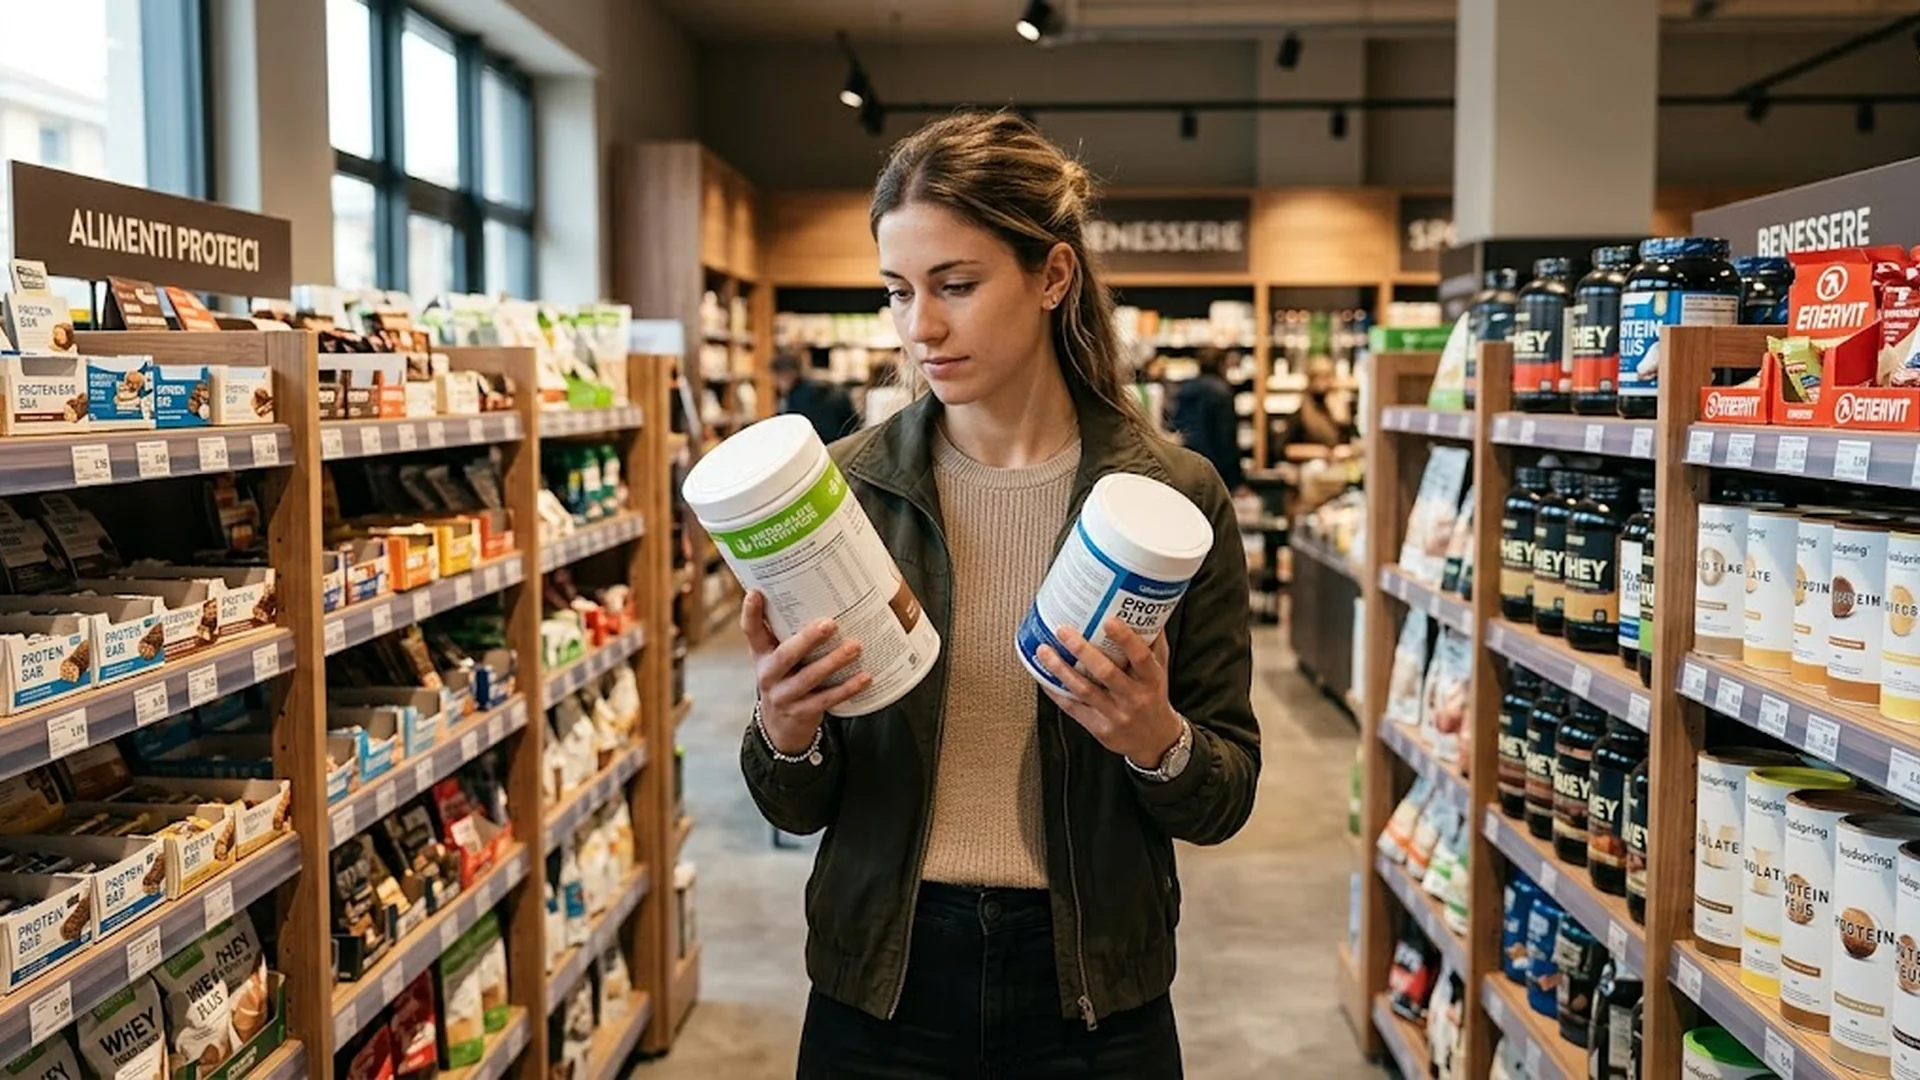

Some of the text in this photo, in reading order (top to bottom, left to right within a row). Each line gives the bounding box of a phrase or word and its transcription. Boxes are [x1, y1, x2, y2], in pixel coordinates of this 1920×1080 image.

[69, 208, 260, 273] ALIMENTI PROTEICI
[1758, 206, 1871, 257] BENESSERE
[1796, 302, 1869, 331] ENERVIT
[1854, 396, 1911, 422] ENERVIT
[99, 1006, 156, 1057] WHEY
